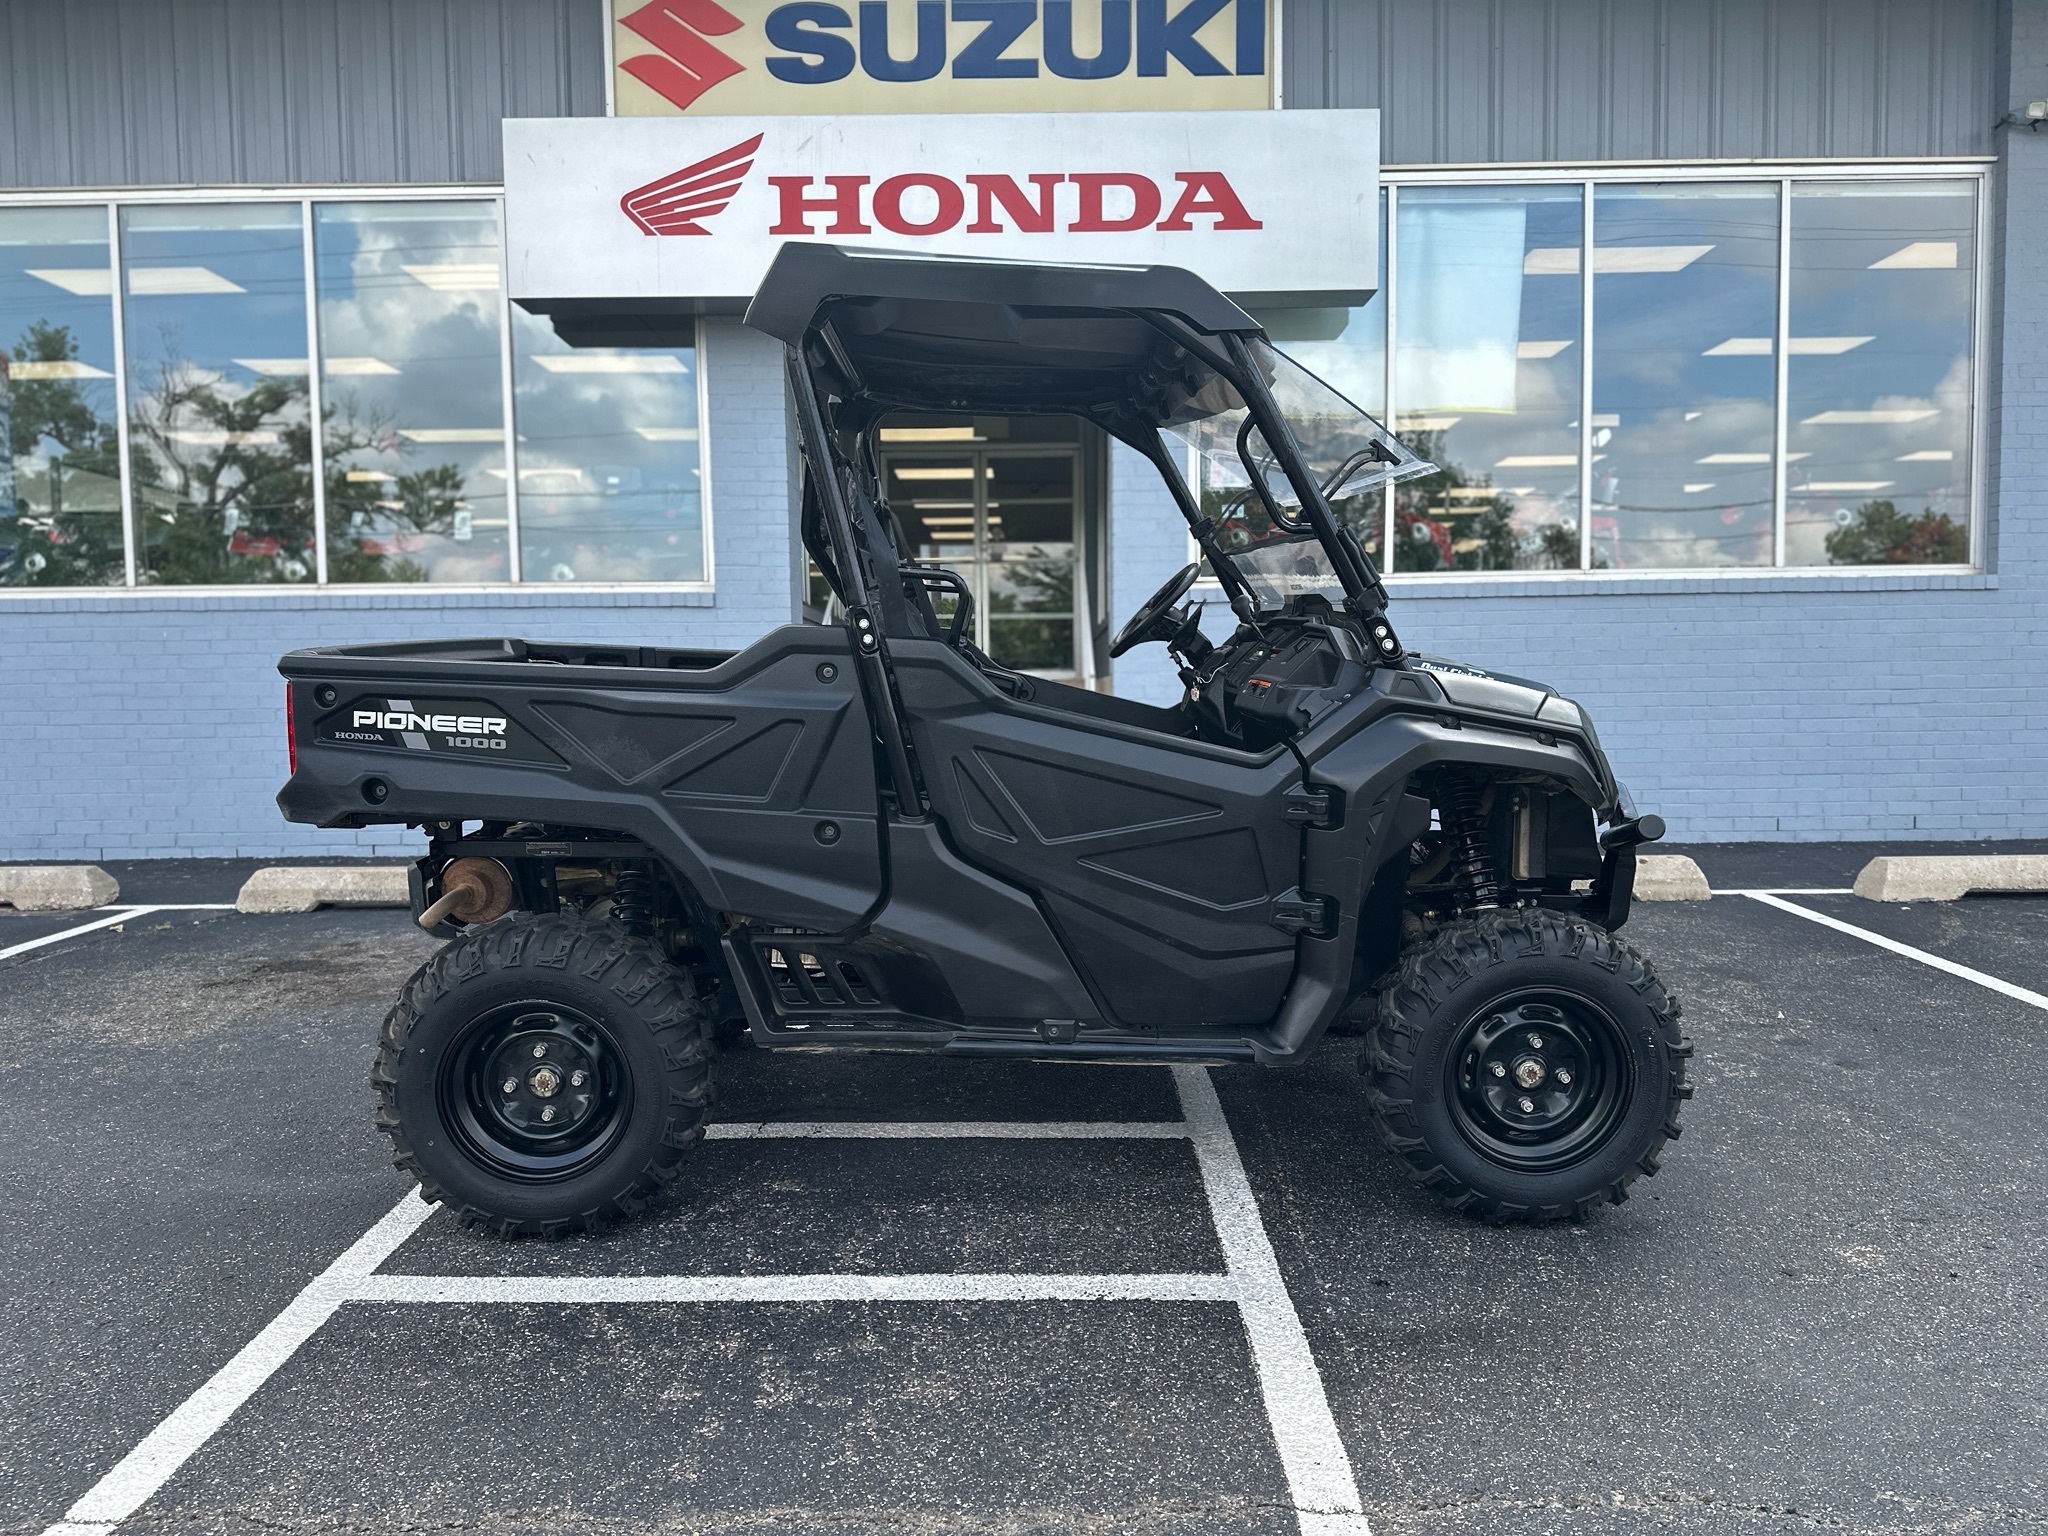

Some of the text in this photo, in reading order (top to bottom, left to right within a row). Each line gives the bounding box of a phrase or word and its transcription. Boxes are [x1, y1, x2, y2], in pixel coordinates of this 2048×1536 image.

[766, 0, 1264, 83] SUZUKI
[769, 172, 1262, 235] HONDA
[353, 710, 507, 735] PIONEER
[334, 731, 384, 741] HONDA
[446, 736, 507, 750] 1000
